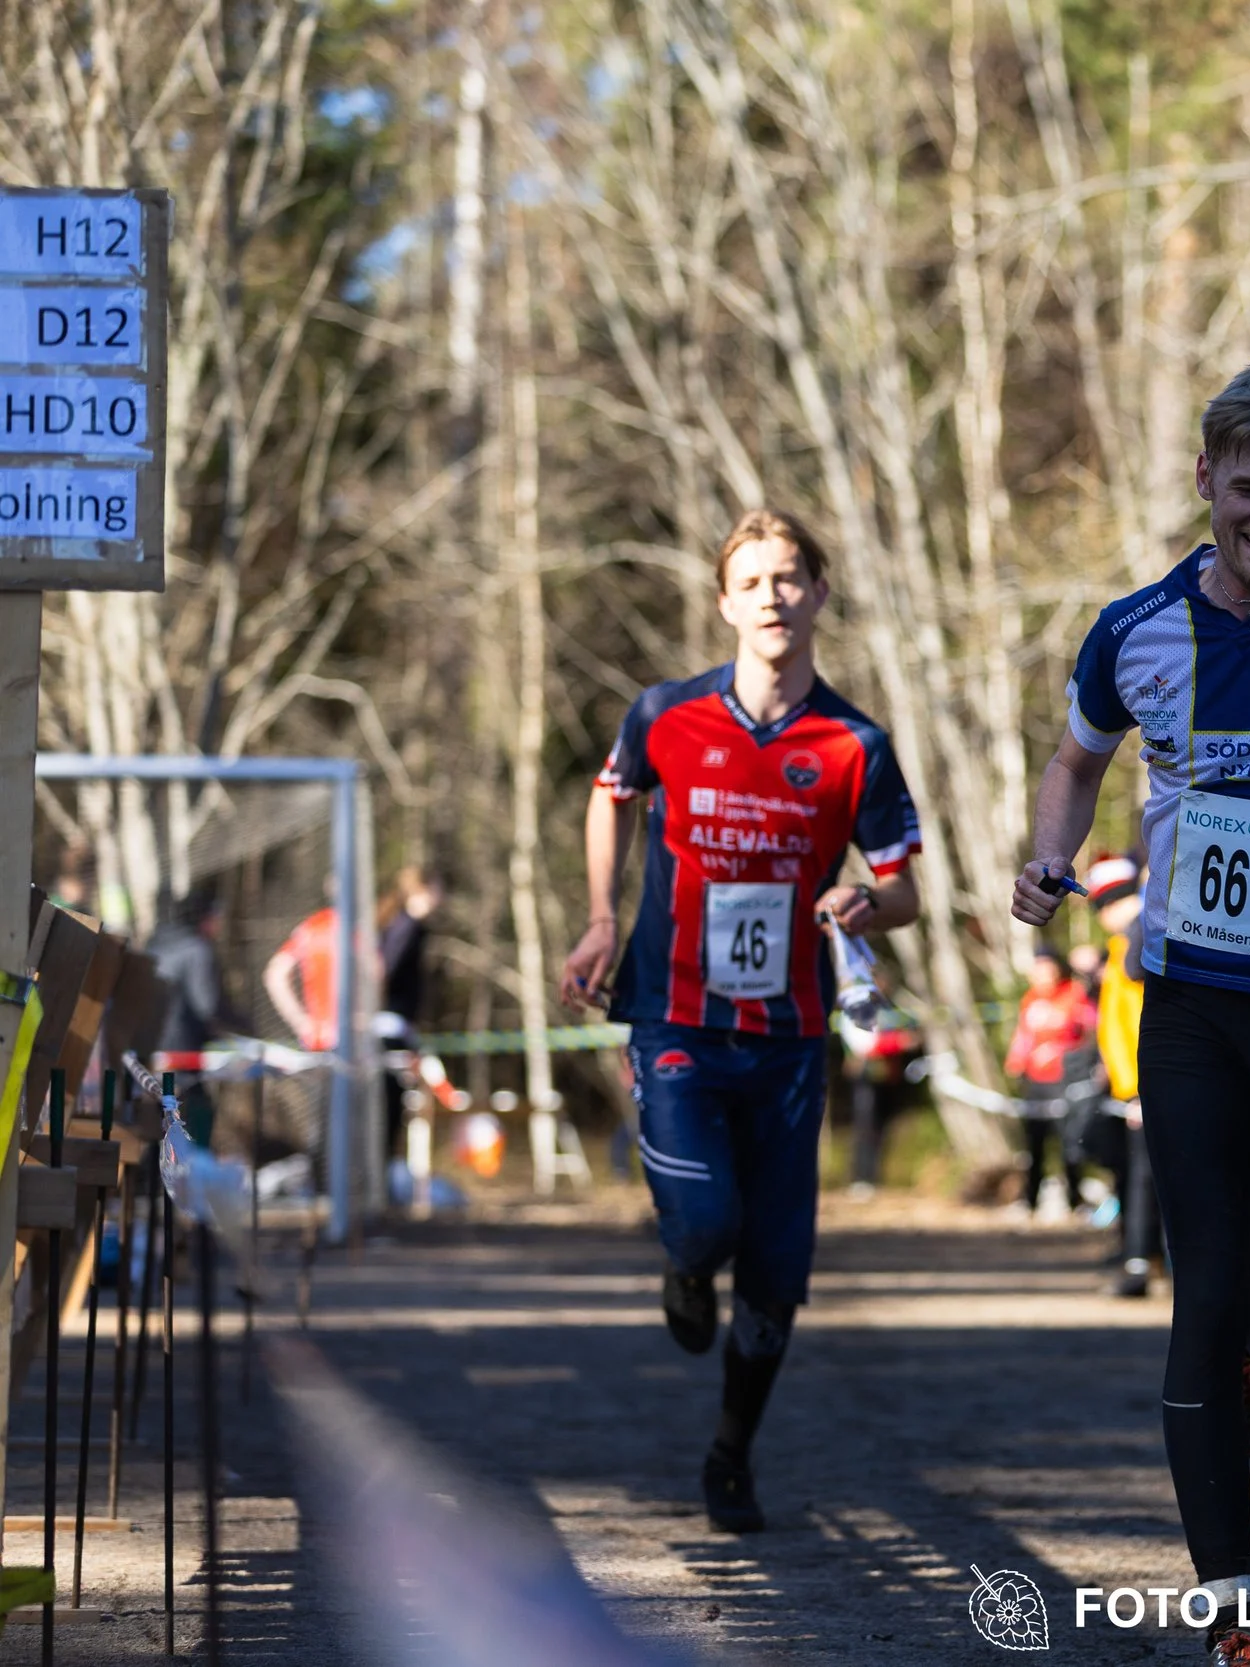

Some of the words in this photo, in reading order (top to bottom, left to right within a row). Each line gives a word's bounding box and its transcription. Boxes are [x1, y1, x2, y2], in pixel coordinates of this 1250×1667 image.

[37, 216, 130, 258] H12
[37, 307, 130, 348] D12
[5, 394, 137, 437] HD10
[1110, 591, 1167, 636] noname
[1136, 685, 1179, 704] Telge
[1186, 810, 1246, 834] NOREX
[1199, 844, 1250, 918] 66
[731, 918, 768, 974] 46
[1181, 920, 1203, 936] OK
